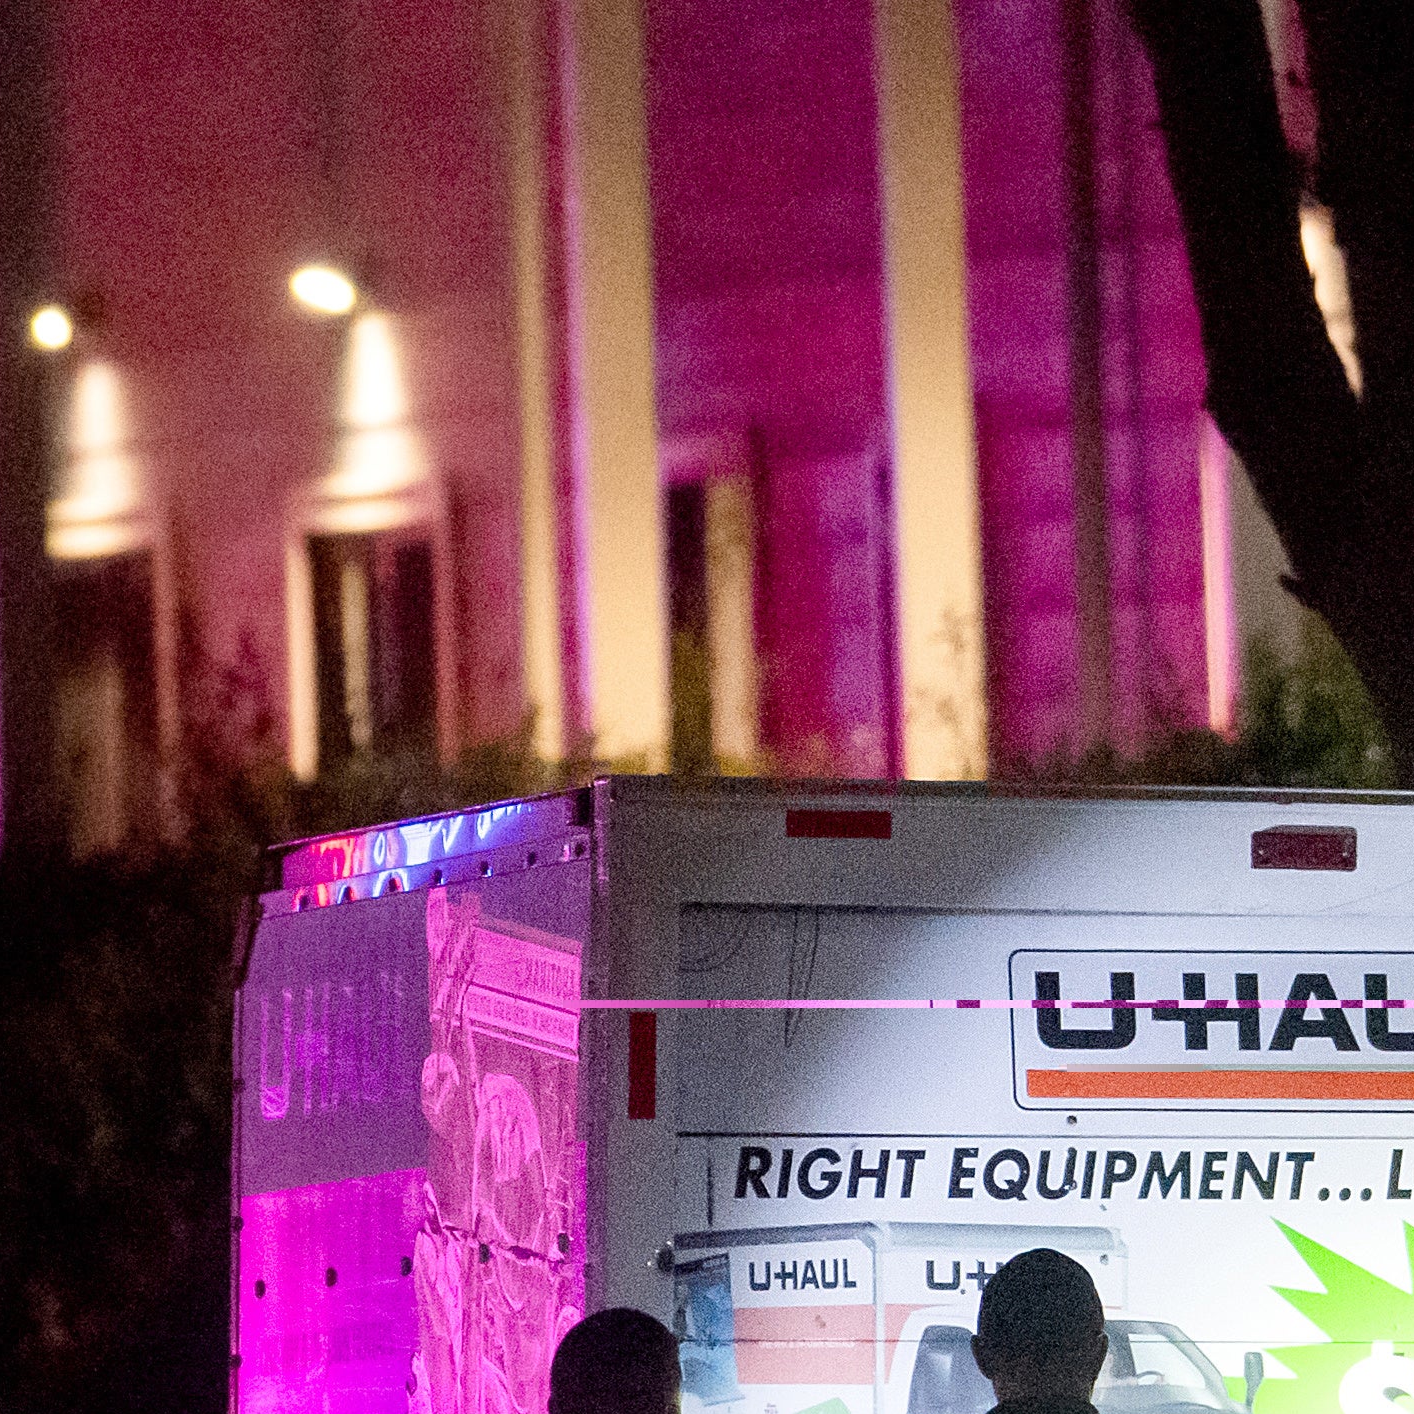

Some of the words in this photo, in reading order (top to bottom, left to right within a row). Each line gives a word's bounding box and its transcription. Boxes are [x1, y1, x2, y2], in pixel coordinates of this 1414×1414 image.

[732, 1146, 925, 1200] RIGHT
[749, 1258, 857, 1291] U-HAUL
[926, 1260, 1003, 1291] U-H
